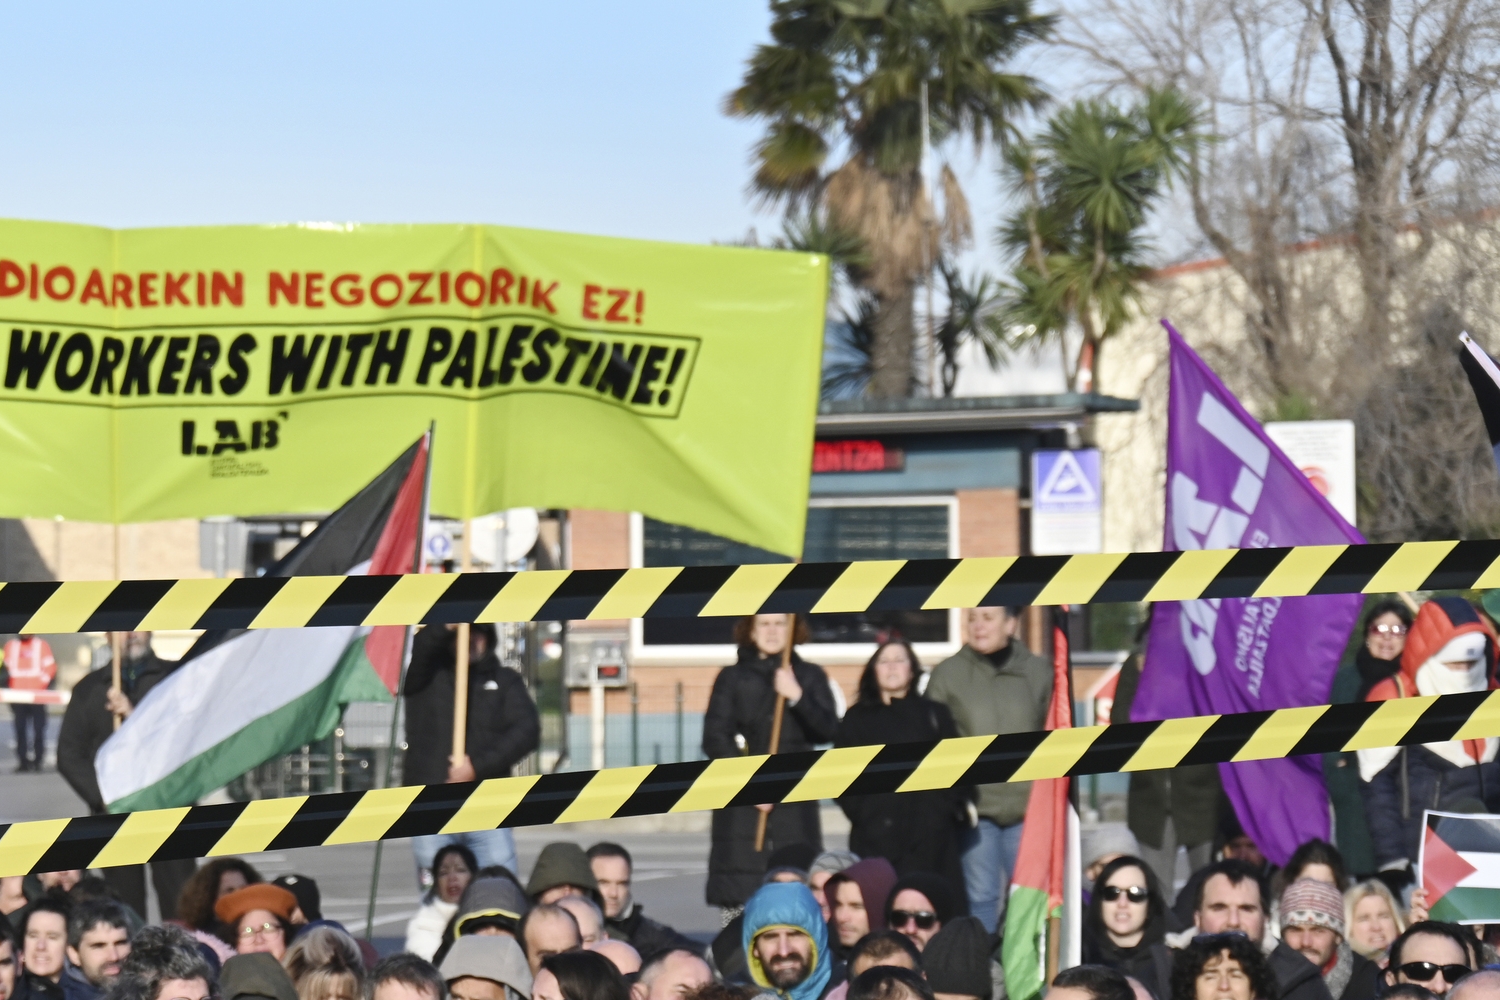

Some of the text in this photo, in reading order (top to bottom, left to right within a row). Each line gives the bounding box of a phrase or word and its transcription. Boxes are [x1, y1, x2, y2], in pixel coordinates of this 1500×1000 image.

[266, 265, 561, 316] NEGOZIORIK
[580, 282, 646, 326] EZ!
[4, 329, 258, 397] WORKERS
[268, 327, 412, 397] WITH
[415, 323, 687, 406] PALESTINE!
[181, 419, 281, 456] LAB
